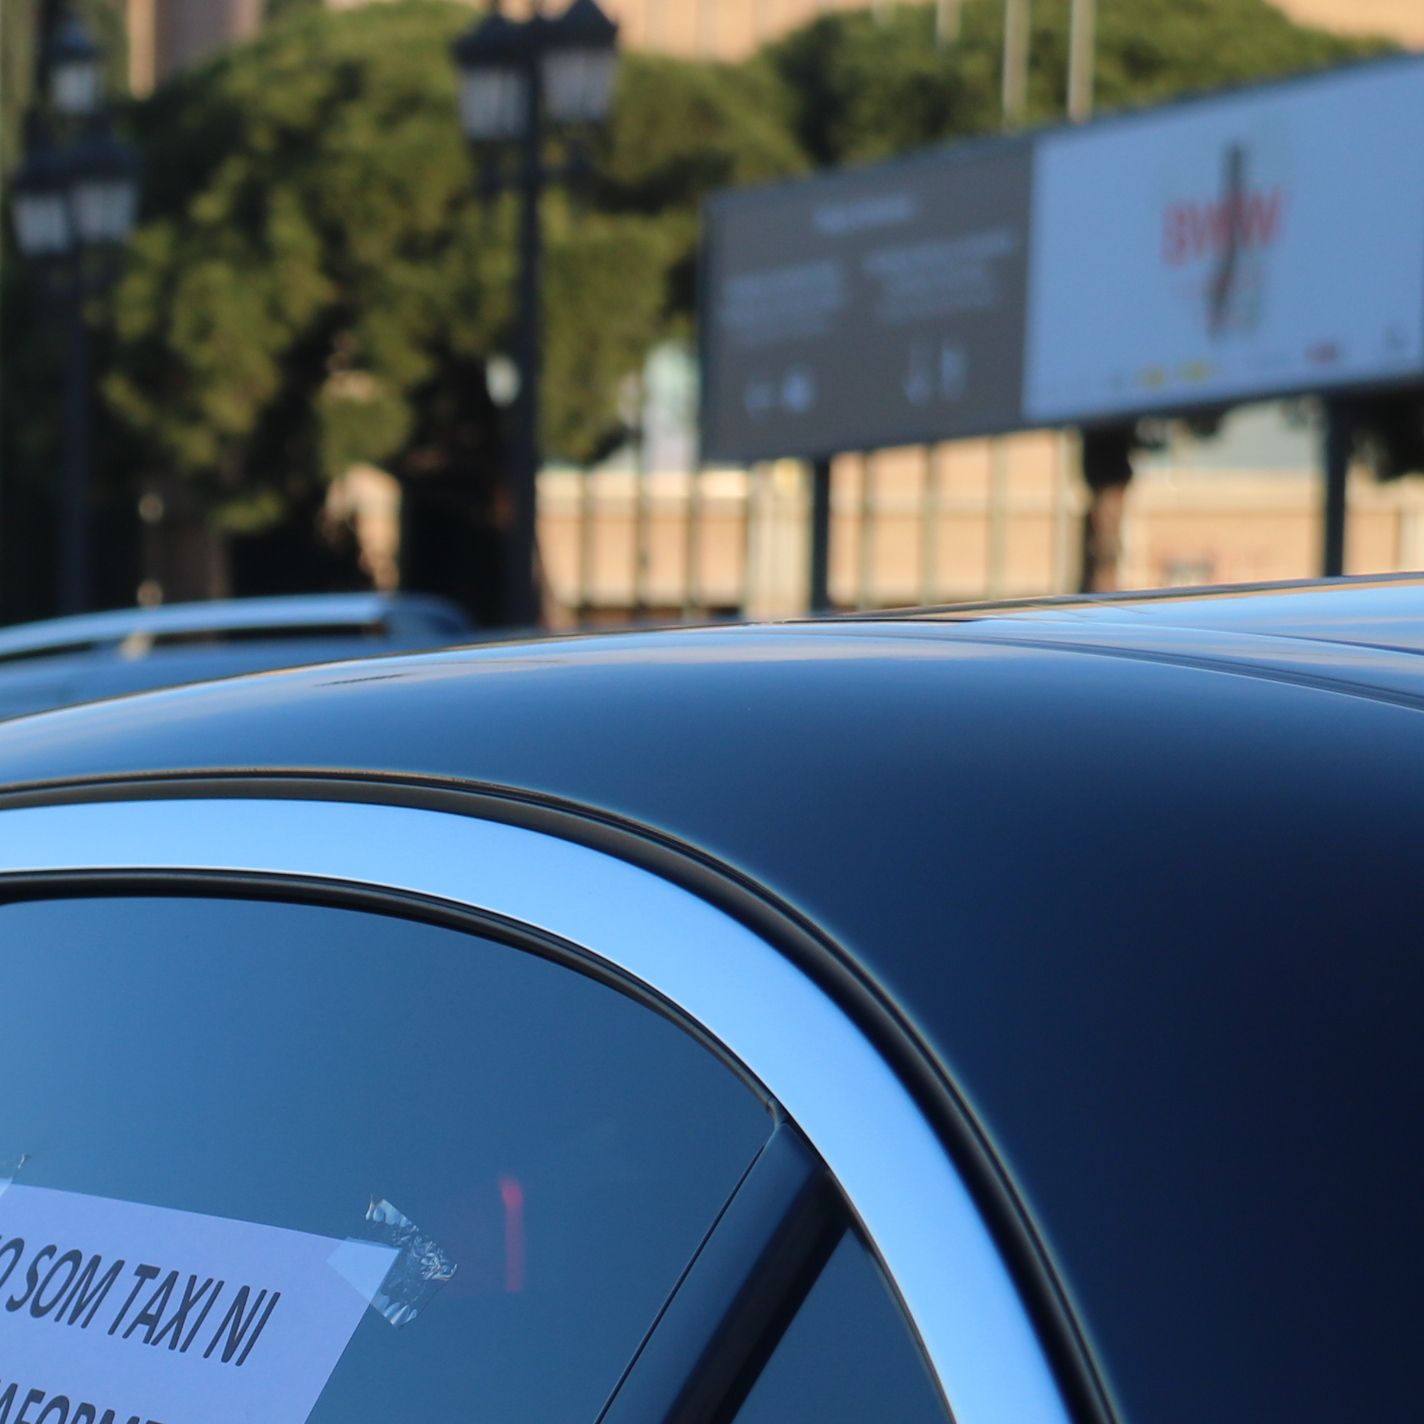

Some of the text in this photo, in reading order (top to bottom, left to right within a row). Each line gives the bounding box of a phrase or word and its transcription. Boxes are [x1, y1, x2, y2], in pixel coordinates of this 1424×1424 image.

[5, 1244, 125, 1329] SOM
[107, 1264, 224, 1353] TAXI
[203, 1285, 281, 1367] NI
